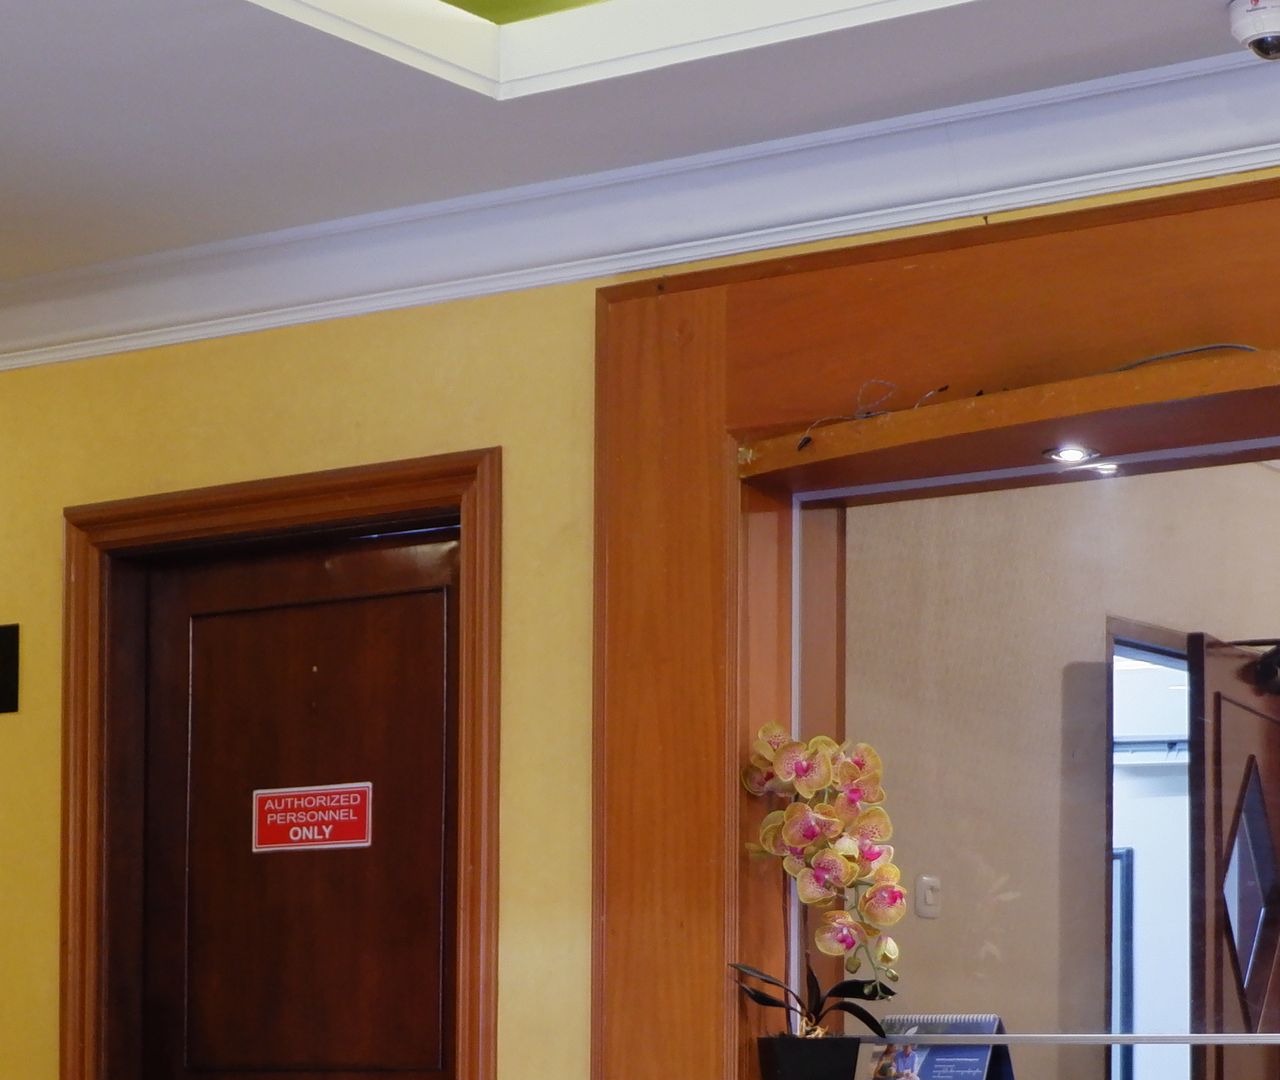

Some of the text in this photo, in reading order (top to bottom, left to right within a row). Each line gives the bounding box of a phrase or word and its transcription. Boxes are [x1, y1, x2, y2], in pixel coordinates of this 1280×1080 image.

[264, 793, 361, 811] AUTHORIZED
[267, 808, 358, 825] PERSONNEL
[289, 825, 333, 841] ONLY
